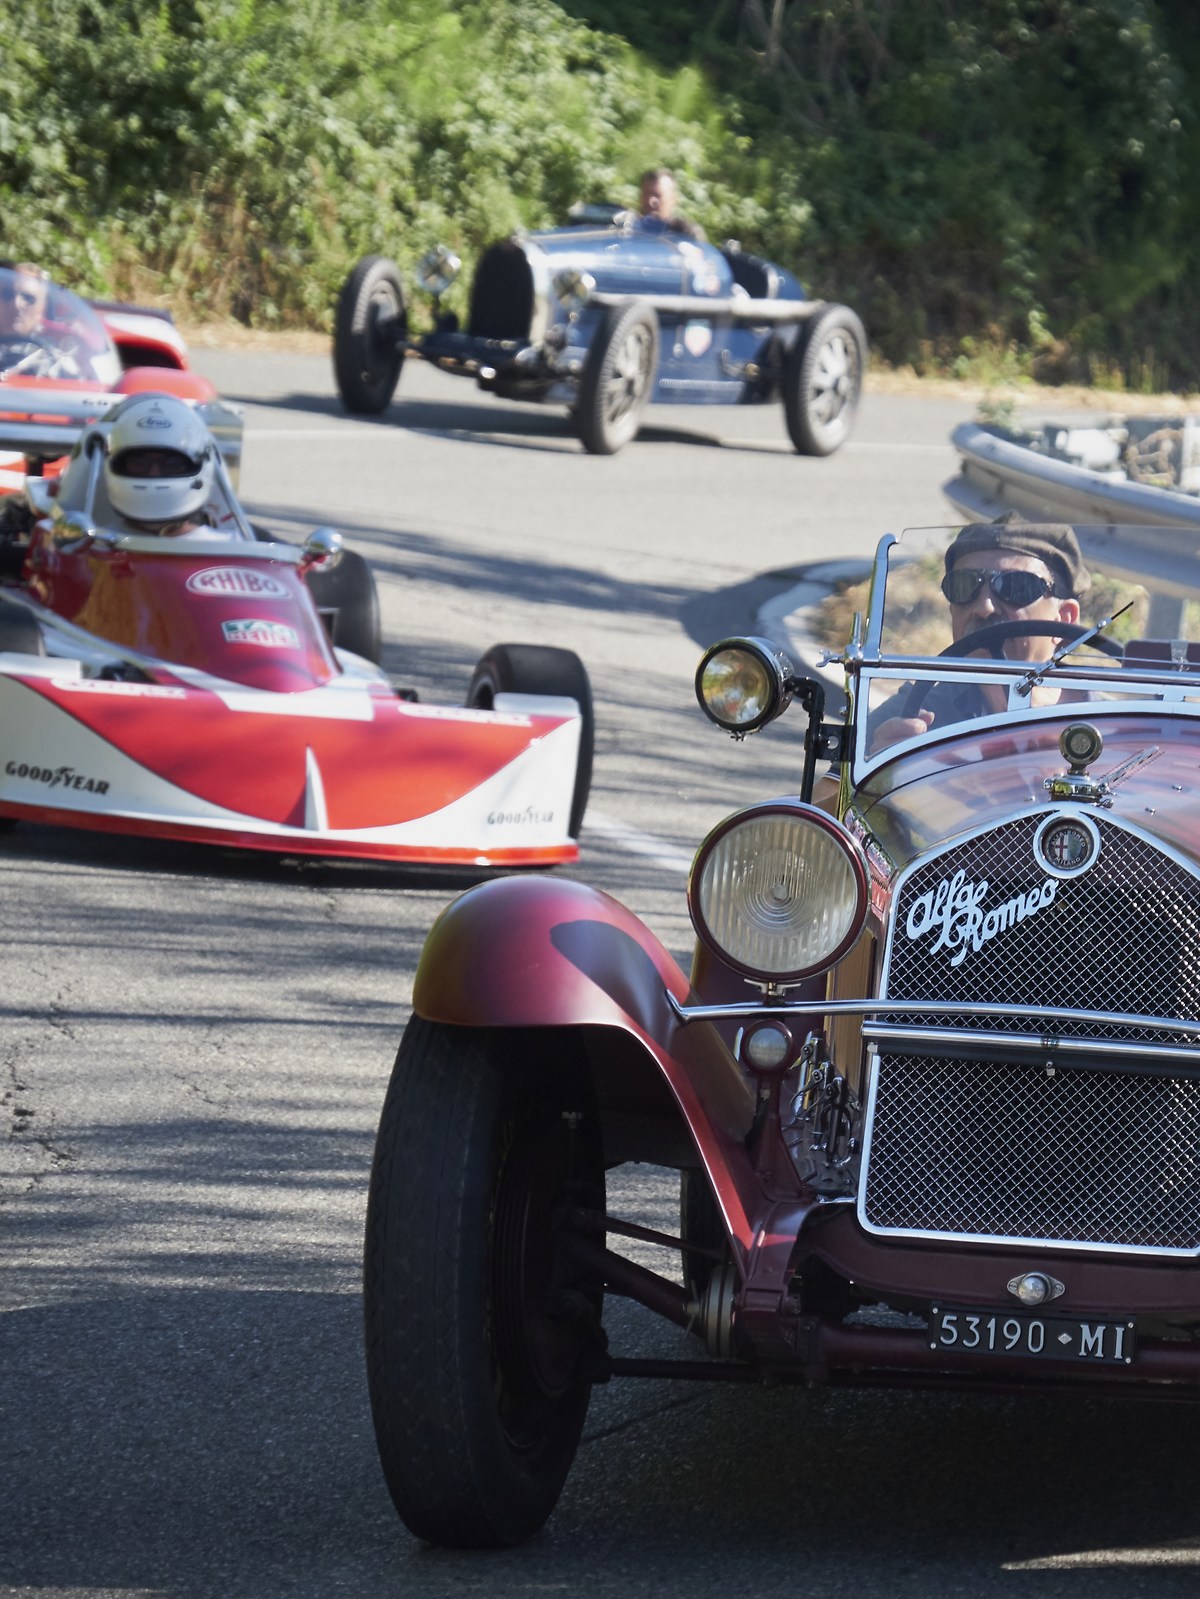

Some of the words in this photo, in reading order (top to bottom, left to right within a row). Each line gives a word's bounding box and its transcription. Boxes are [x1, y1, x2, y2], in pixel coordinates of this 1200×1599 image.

[5, 761, 110, 795] GOODYEAR
[1055, 856, 1081, 866] MILANO
[906, 869, 989, 955] Alfa
[944, 879, 1060, 967] Romeo
[940, 1315, 1045, 1353] 53190
[1079, 1324, 1125, 1359] MI
